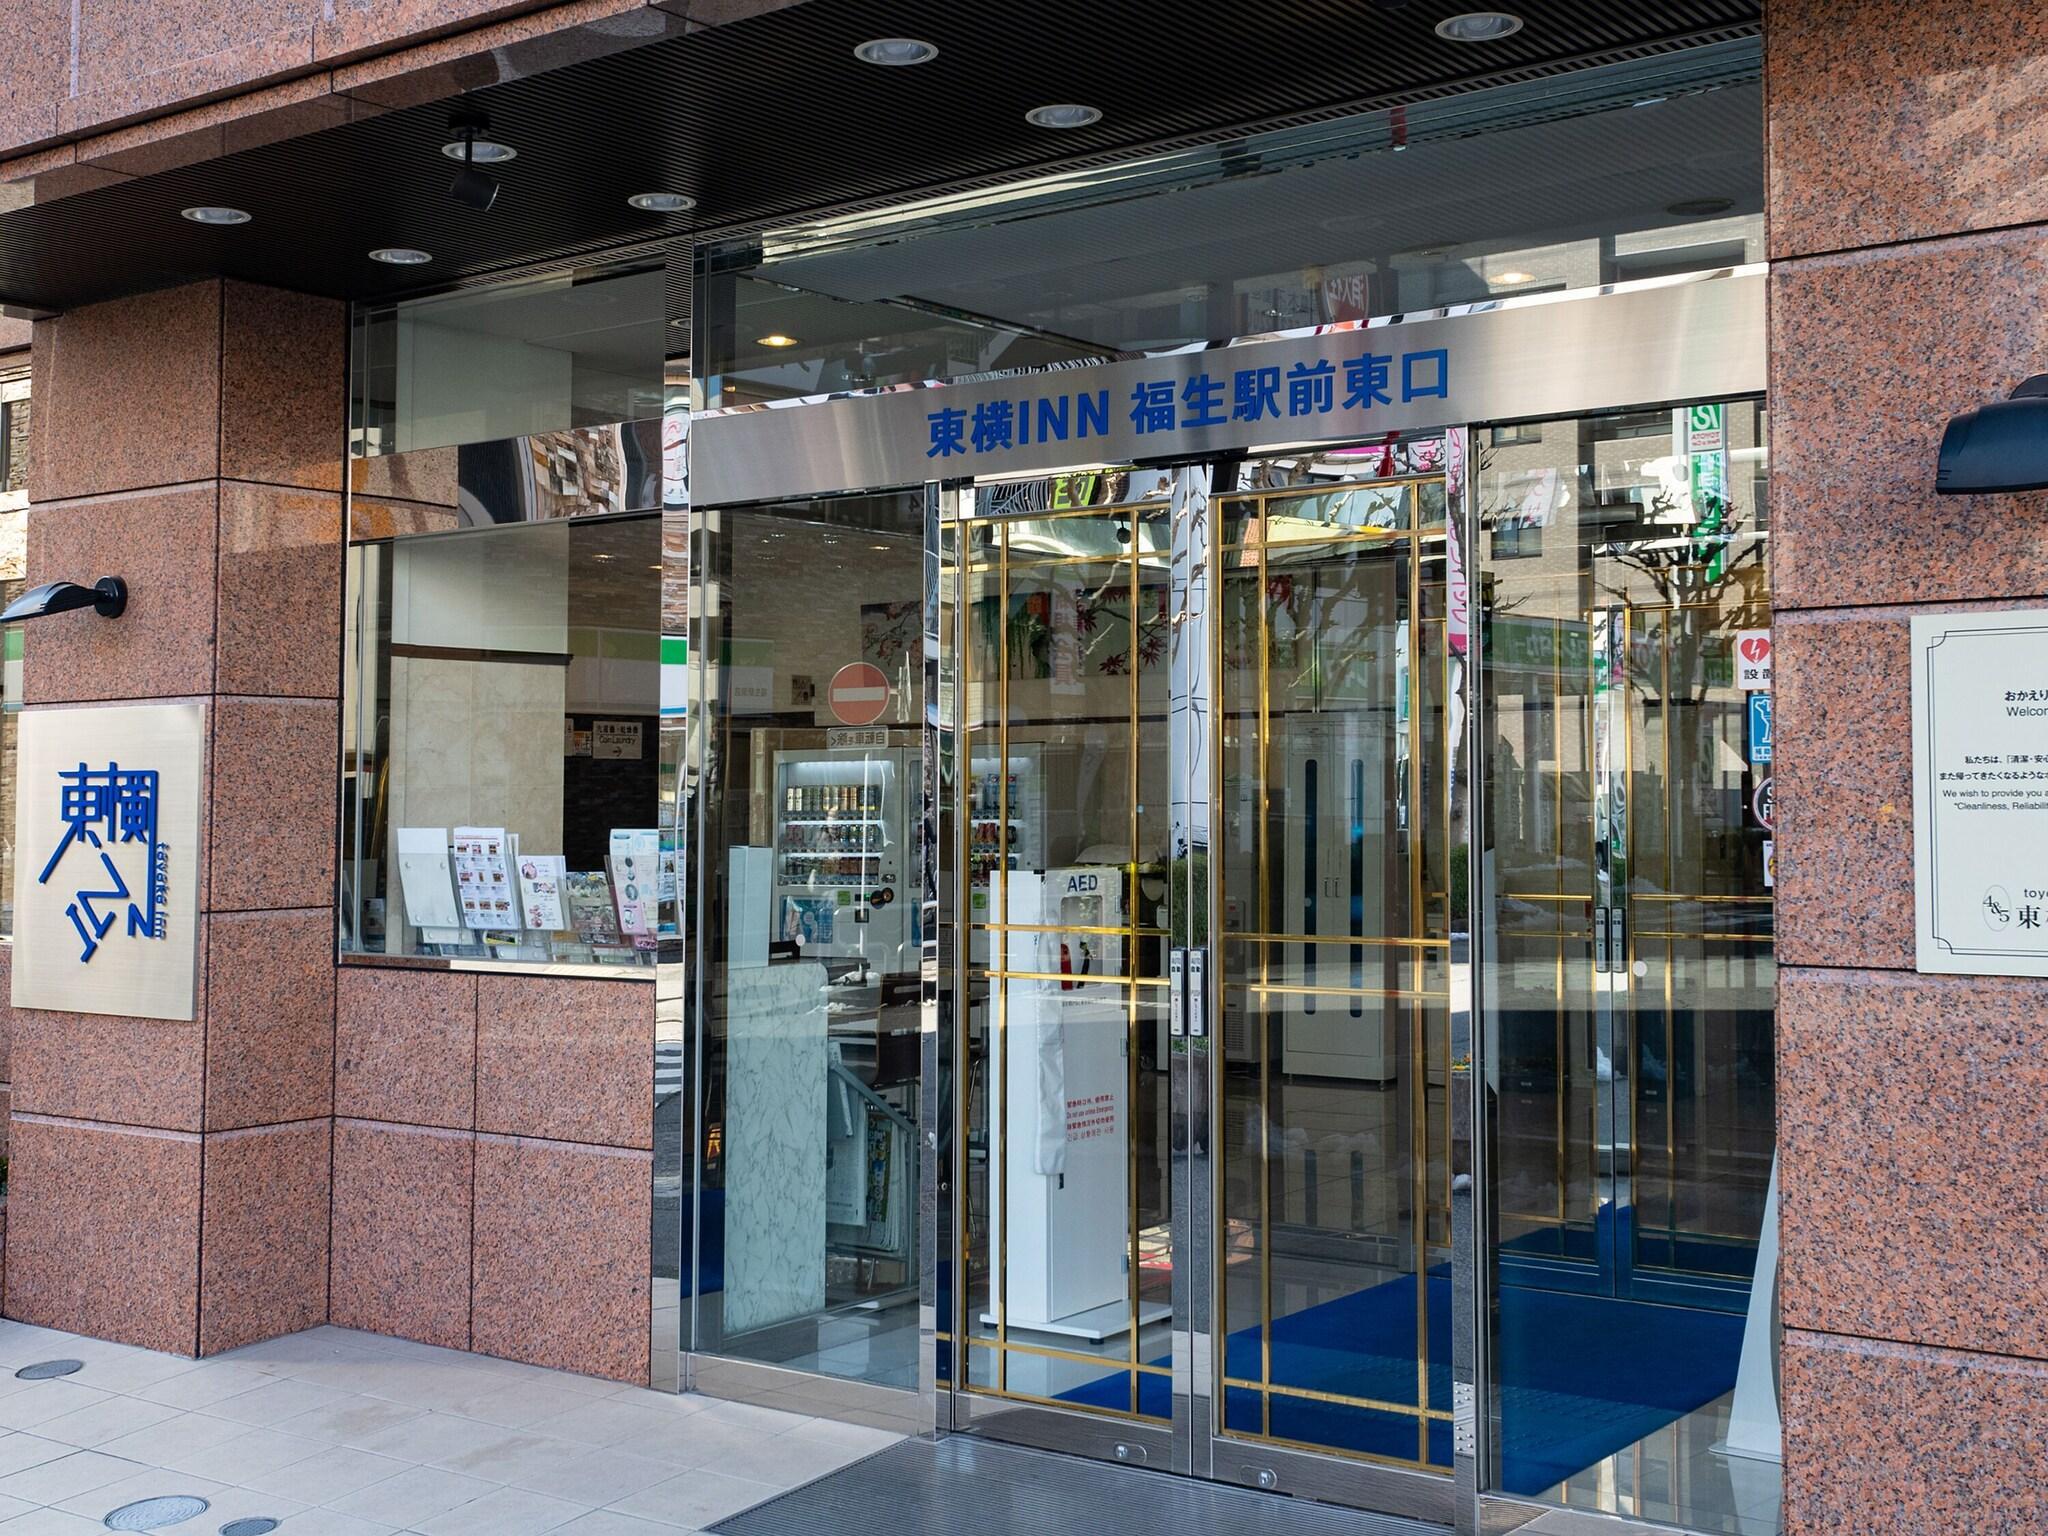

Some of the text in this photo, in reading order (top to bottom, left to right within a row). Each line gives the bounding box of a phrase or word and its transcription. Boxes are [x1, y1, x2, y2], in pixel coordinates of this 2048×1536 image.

[926, 347, 1449, 458] 東横INN 福生駅前東口
[1942, 789, 1957, 798] We
[1959, 789, 1979, 798] wish
[1981, 790, 1989, 798] to
[1991, 789, 2024, 801] provide
[2026, 791, 2042, 801] you
[1067, 874, 1098, 892] AED
[2023, 888, 2048, 900] toy
[2015, 904, 2048, 930] 東
